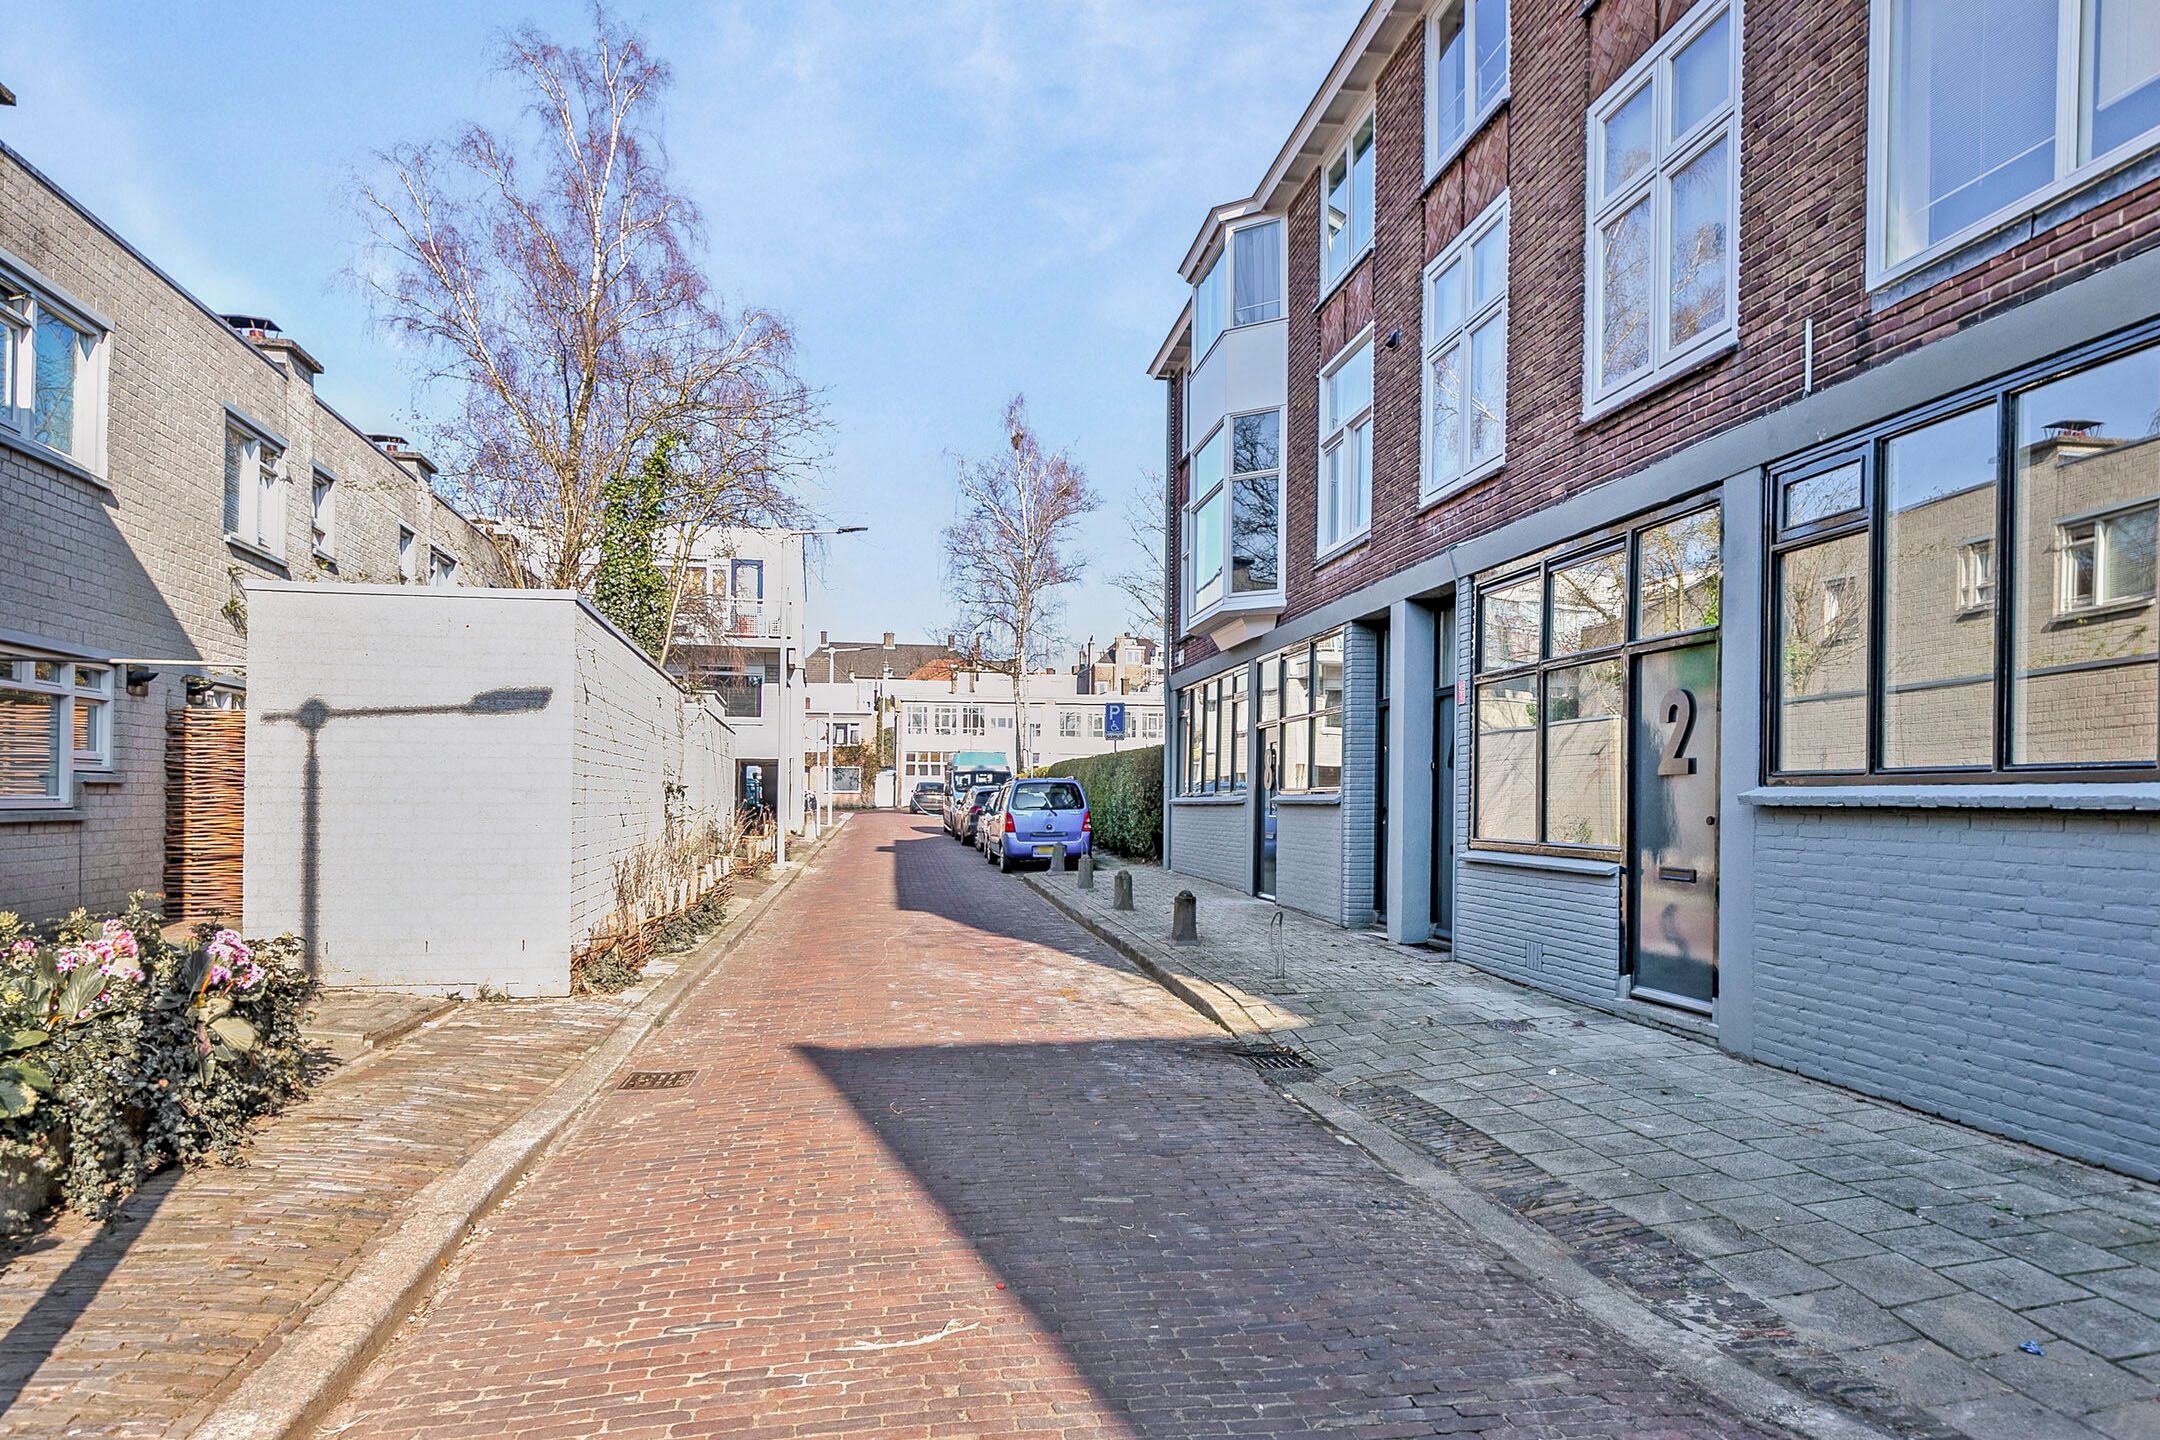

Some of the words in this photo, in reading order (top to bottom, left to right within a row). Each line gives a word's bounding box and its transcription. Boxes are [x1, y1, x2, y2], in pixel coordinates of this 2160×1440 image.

[1110, 705, 1120, 720] P
[1658, 688, 1697, 775] 2
[1264, 748, 1274, 790] 8
